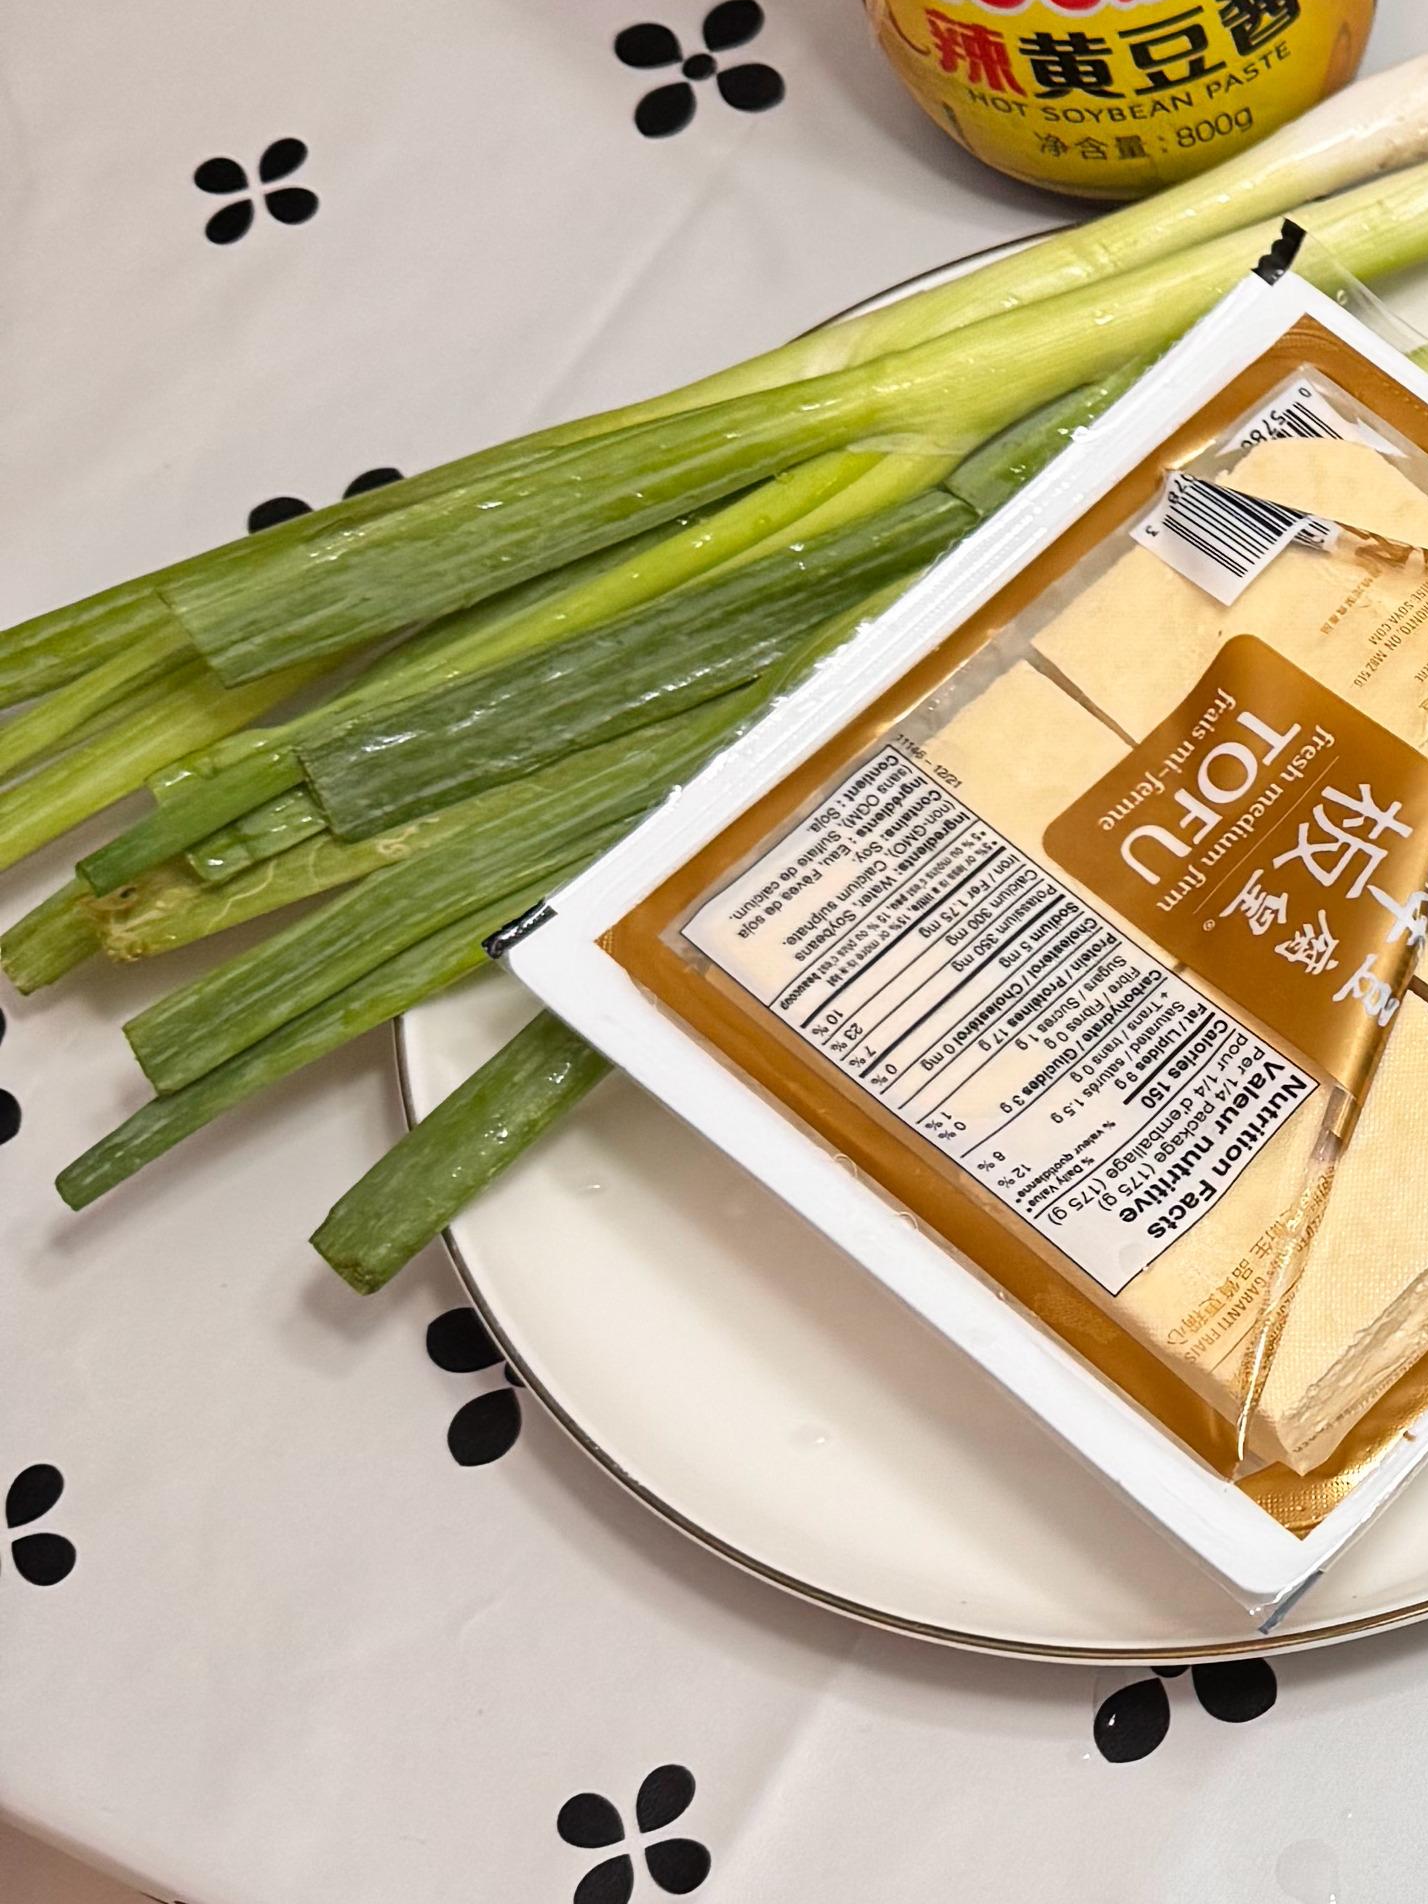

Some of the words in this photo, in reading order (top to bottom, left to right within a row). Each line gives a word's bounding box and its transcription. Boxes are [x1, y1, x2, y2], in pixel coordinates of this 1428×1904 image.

[967, 88, 1028, 119] HOT
[1044, 91, 1193, 125] SOYBEAN
[1206, 41, 1291, 100] PASTE
[1192, 688, 1236, 739] frais
[1280, 725, 1335, 781] fresh
[843, 755, 899, 801] Contient
[877, 764, 913, 794] (sans
[837, 794, 880, 828] OGM),
[856, 776, 928, 837] Ingrédients
[1120, 712, 1301, 885] TOFU
[807, 807, 841, 833] Soja.
[880, 790, 942, 841] Contains:
[1201, 783, 1284, 866] medium
[884, 800, 956, 858] (non-GMO),
[797, 831, 841, 866] Sulfate
[818, 844, 851, 866] Eau,
[852, 841, 883, 863] Soy.
[894, 812, 970, 875] Ingredients:
[780, 867, 798, 881] de
[993, 854, 1020, 874] Iron
[781, 869, 822, 900] Fèves
[836, 860, 887, 901] Calcium
[852, 876, 897, 907] Water,
[967, 880, 991, 899] Fer
[990, 869, 1038, 908] Calcium
[1156, 865, 1206, 911] firm
[729, 881, 780, 919] calcium.
[764, 901, 782, 915] de
[940, 900, 968, 923] 1.75
[995, 884, 1057, 934] Potassium
[737, 915, 765, 938] soja
[782, 901, 838, 945] sulphate.
[918, 920, 942, 938] mg
[967, 908, 992, 930] 300
[1030, 902, 1079, 941] Sodium
[795, 910, 856, 961] Soybeans
[945, 928, 969, 946] mg
[973, 933, 999, 956] 350
[1020, 941, 1033, 952] 5
[1027, 918, 1098, 979] Cholesterol
[951, 954, 975, 972] mg
[999, 950, 1022, 968] mg
[1070, 932, 1117, 971] Protein
[1084, 956, 1127, 992] Sugars
[1108, 966, 1141, 993] Fibre
[952, 983, 1023, 1046] Cholestérol
[1007, 976, 1067, 1027] Protéines
[1082, 970, 1162, 1042] Carbohydrate
[1183, 1003, 1207, 1024] Fat
[826, 1010, 843, 1025] 10
[1037, 997, 1080, 1033] Sucres
[1066, 999, 1105, 1032] Fibres
[1127, 1002, 1163, 1031] Trans
[1129, 1001, 1185, 1054] Saturated
[812, 1025, 829, 1036] %
[844, 1023, 863, 1040] 23
[993, 1029, 1008, 1044] 17
[1028, 1034, 1039, 1042] 1
[1044, 1038, 1057, 1049] g
[1056, 1032, 1069, 1042] 0
[830, 1042, 848, 1052] %
[865, 1046, 876, 1057] 7
[943, 1044, 955, 1054] 0
[978, 1039, 992, 1051] g
[1015, 1038, 1028, 1050] g
[1092, 1037, 1124, 1065] trans
[1135, 1029, 1182, 1071] Lipides
[1168, 1020, 1228, 1079] Calories
[1217, 1033, 1248, 1071] pour
[849, 1057, 866, 1067] %
[885, 1064, 897, 1075] 0
[920, 1052, 944, 1071] mg
[1022, 1048, 1078, 1096] Glucides
[1082, 1065, 1094, 1075] 0
[1238, 1046, 1265, 1075] Per
[871, 1075, 888, 1084] %
[1070, 1072, 1083, 1083] g
[1114, 1078, 1127, 1090] g
[1126, 1072, 1138, 1082] 9
[1193, 1075, 1218, 1097] 1/4
[1215, 1078, 1238, 1101] 1/4
[1000, 1102, 1013, 1113] g
[1012, 1095, 1025, 1106] 3
[1063, 1099, 1084, 1117] 1.5
[1141, 1082, 1171, 1108] 150
[1215, 1062, 1285, 1135] Valeur
[954, 1122, 966, 1131] 0
[1051, 1112, 1064, 1123] g
[1212, 1074, 1307, 1176] Nutrition
[938, 1130, 957, 1140] %
[1106, 1098, 1193, 1178] d'emballage
[1154, 1100, 1215, 1163] package
[977, 1160, 995, 1172] %
[1011, 1164, 1031, 1178] 12
[1119, 1136, 1214, 1222] nutritive
[997, 1177, 1016, 1188] %
[1118, 1163, 1155, 1197] (175
[1068, 1178, 1107, 1211] (175
[1098, 1192, 1117, 1211] g)
[1048, 1206, 1067, 1225] g)
[1147, 1179, 1217, 1238] Facts
[1215, 1274, 1268, 1332] GARANTI
[1182, 1326, 1222, 1365] FRAIS
